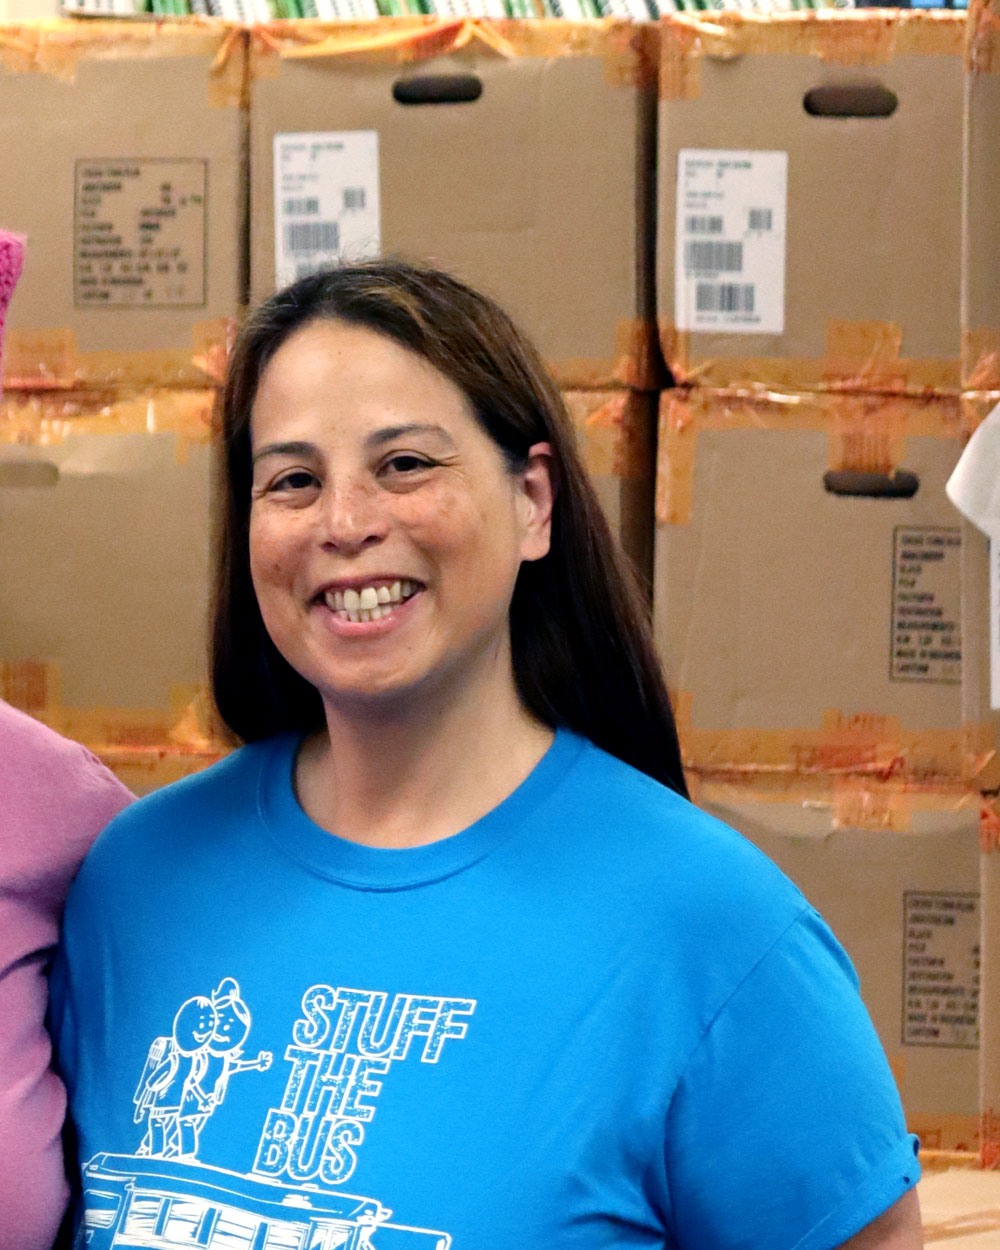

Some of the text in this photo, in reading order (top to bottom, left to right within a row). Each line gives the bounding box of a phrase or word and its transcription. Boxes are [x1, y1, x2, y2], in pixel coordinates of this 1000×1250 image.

[292, 984, 477, 1063] STUFF
[281, 1045, 391, 1122] THE
[252, 1108, 365, 1184] BUS
